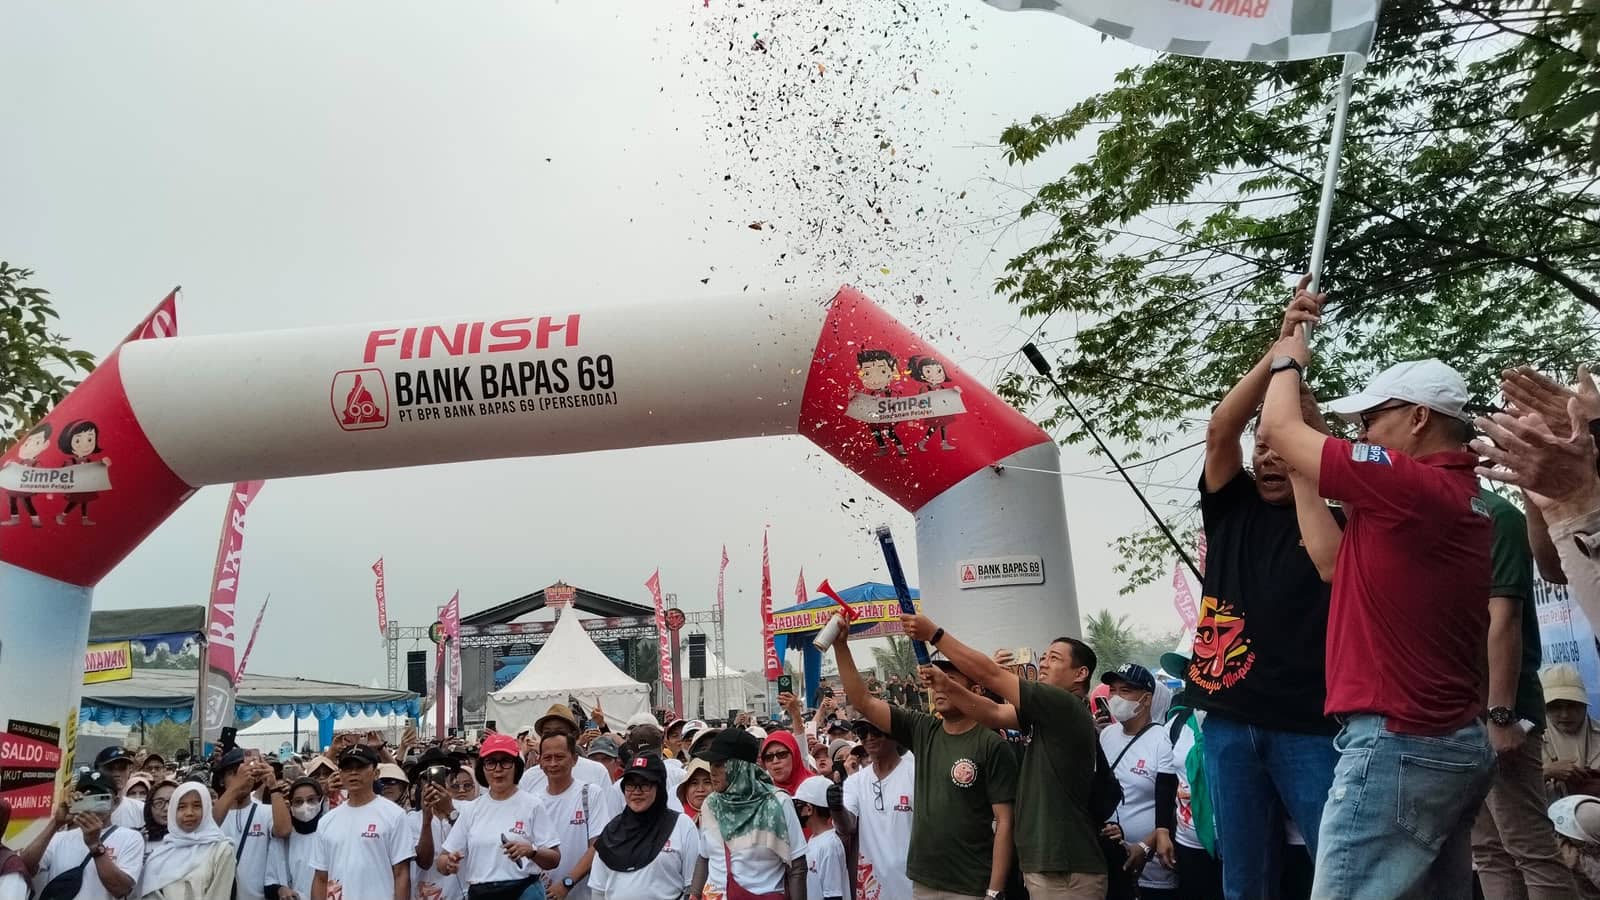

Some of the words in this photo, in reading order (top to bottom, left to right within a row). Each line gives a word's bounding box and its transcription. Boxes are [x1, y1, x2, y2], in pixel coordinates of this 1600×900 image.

[363, 313, 581, 363] FINISH
[395, 366, 474, 406] BANK
[480, 358, 570, 399] BAPAS
[577, 354, 615, 391] 69
[399, 409, 413, 422] PT
[417, 407, 440, 420] BPR
[444, 404, 476, 418] BANK
[479, 401, 516, 415] BAPAS
[520, 399, 535, 412] 69
[539, 391, 618, 410] (PERSERODA)
[878, 396, 931, 414] SimPel
[1368, 445, 1381, 462] BPR
[21, 470, 75, 484] SimPel
[977, 564, 1001, 576] BANK
[1002, 562, 1028, 574] BAPAS
[1029, 561, 1040, 573] 69
[1188, 664, 1222, 695] Menuju
[1222, 651, 1256, 688] Mapan
[0, 741, 43, 762] SALDO
[38, 795, 52, 808] LPS
